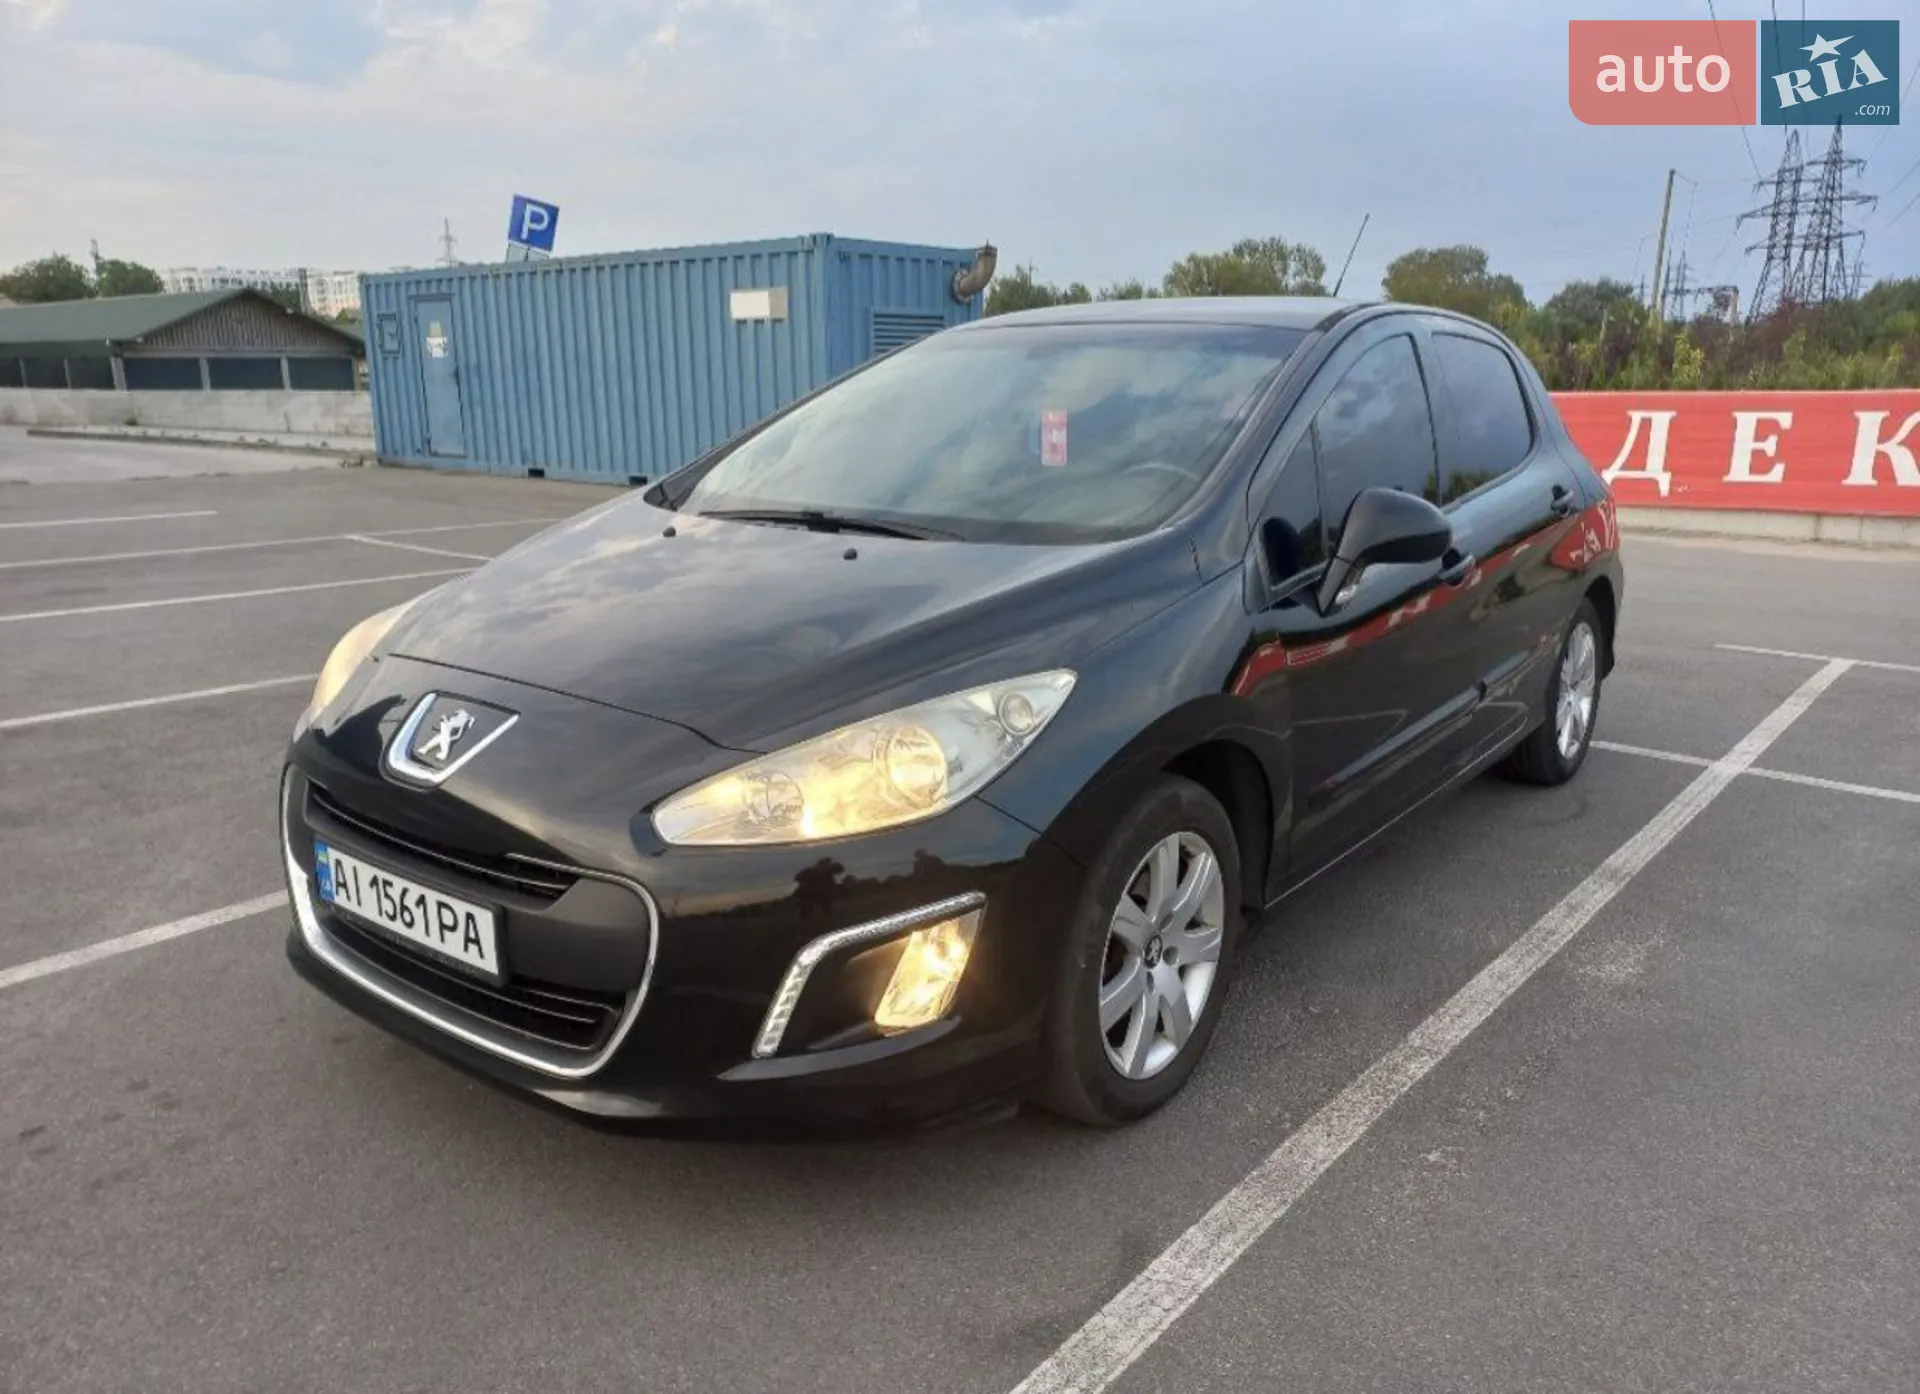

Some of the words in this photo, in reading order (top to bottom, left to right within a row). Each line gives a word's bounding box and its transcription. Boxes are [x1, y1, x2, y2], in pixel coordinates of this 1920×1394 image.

[520, 203, 549, 240] P
[335, 857, 362, 907] AI
[369, 873, 431, 937] 1561
